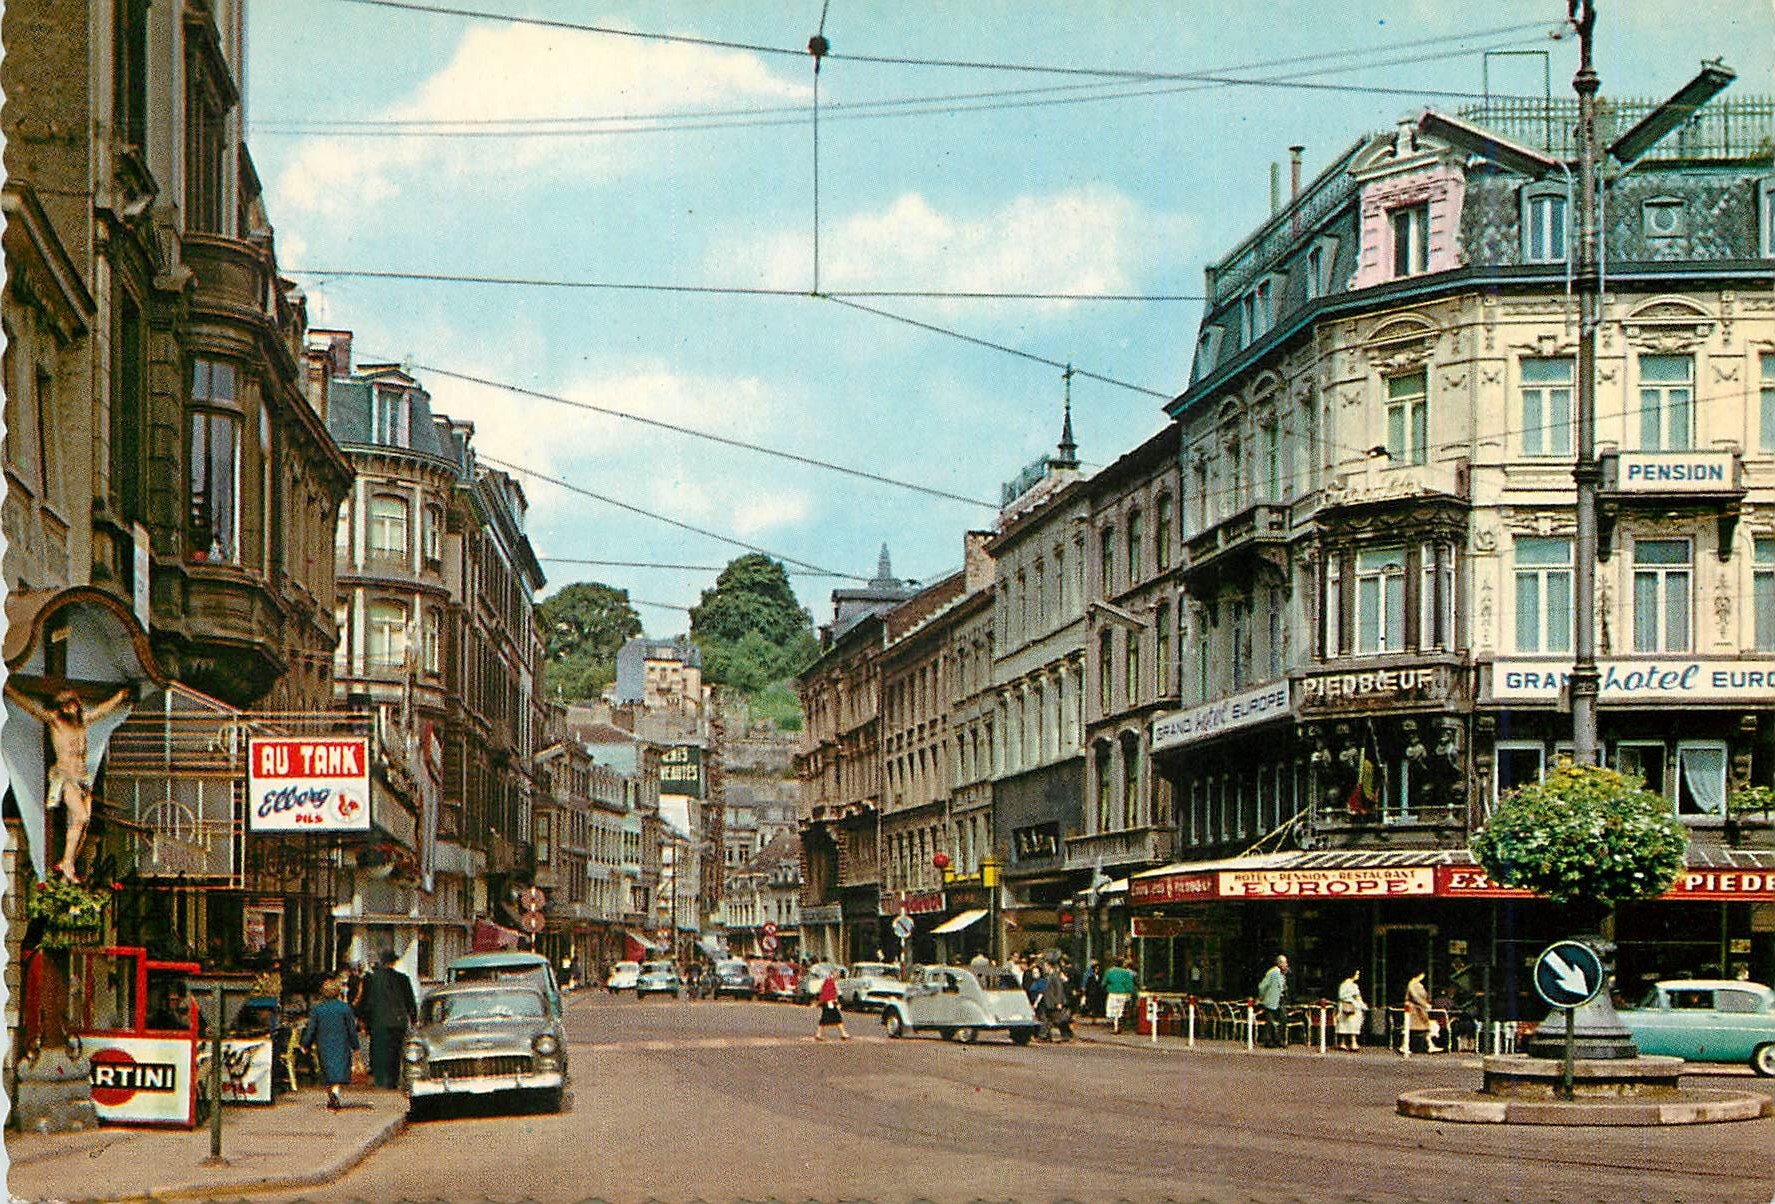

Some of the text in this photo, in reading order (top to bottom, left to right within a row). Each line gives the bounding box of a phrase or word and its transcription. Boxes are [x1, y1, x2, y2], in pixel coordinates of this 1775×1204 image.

[1628, 463, 1724, 481] PENSION
[1505, 671, 1573, 690] GRAN
[1604, 663, 1699, 692] hotel
[1232, 690, 1286, 719] EUROPE
[261, 744, 359, 776] AU TANK
[295, 814, 324, 824] PILS
[1234, 869, 1415, 882] HOTEL PENSION RESTAURANT
[1241, 879, 1409, 896] EUROPE
